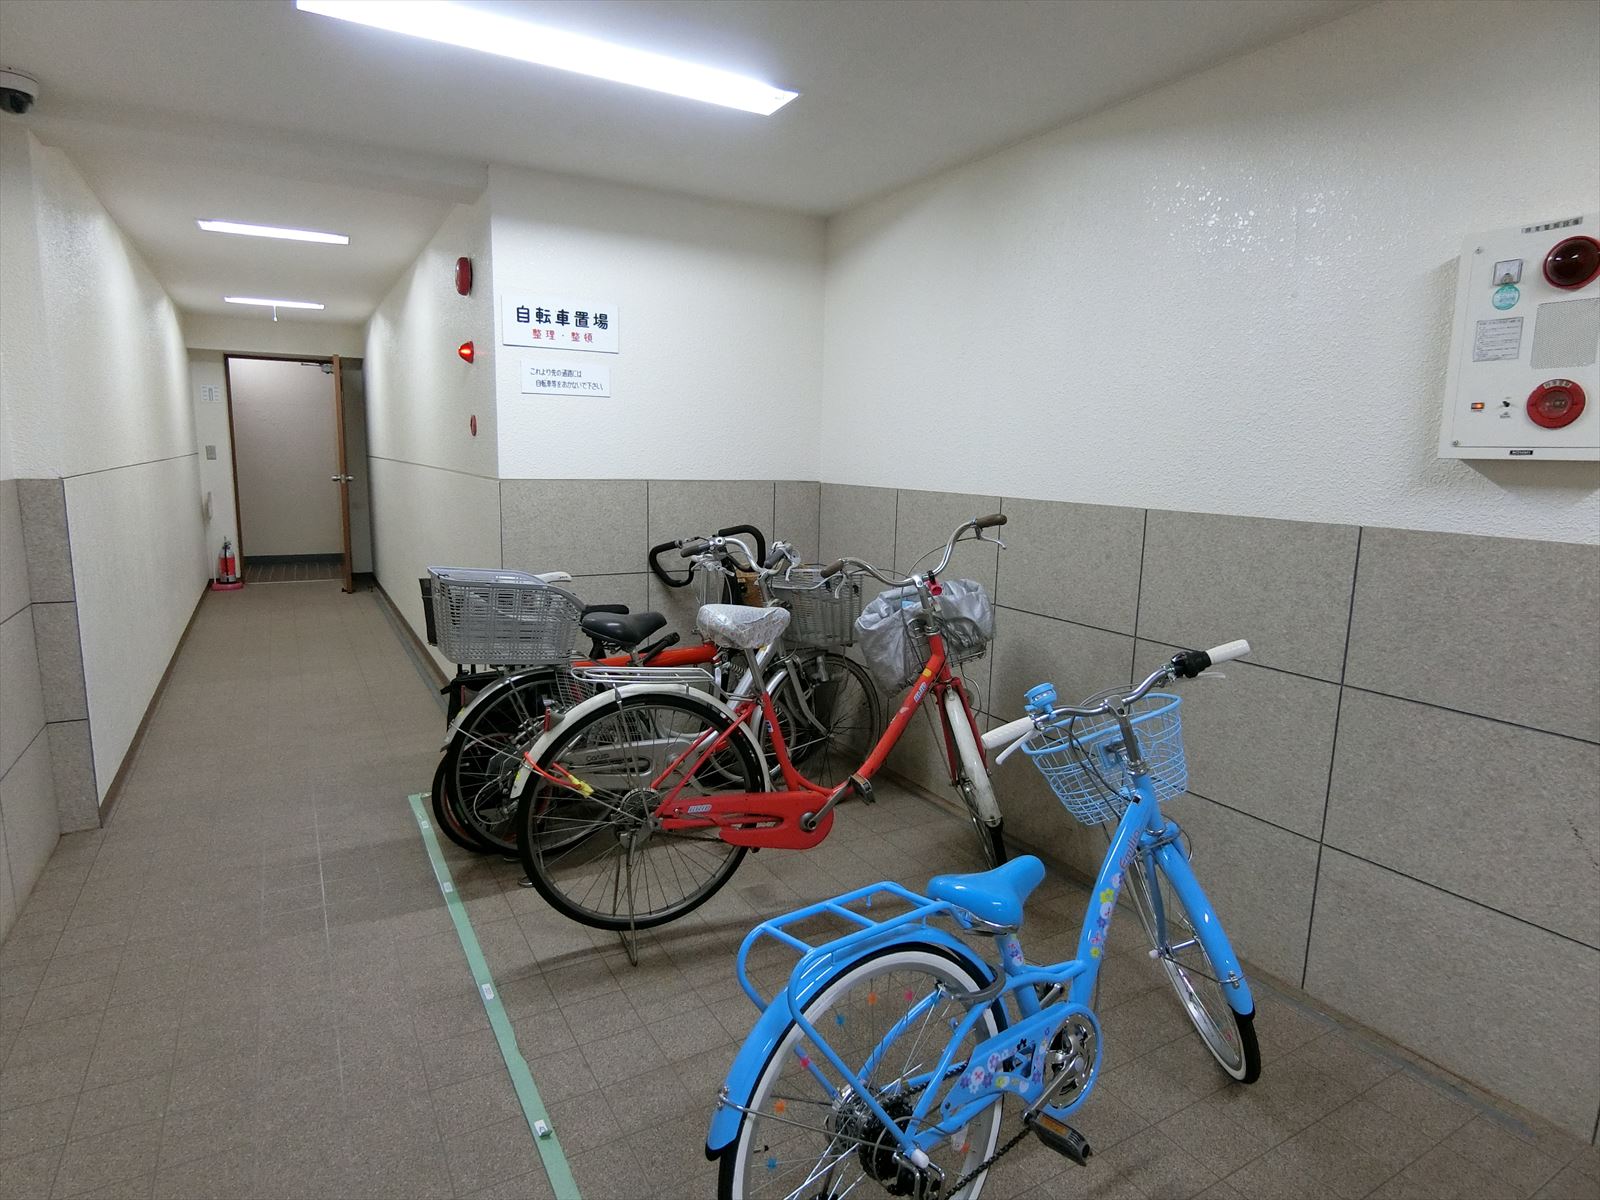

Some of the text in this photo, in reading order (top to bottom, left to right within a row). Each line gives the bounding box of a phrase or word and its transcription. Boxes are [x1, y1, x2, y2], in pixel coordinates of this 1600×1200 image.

[516, 305, 609, 330] 自転車置場
